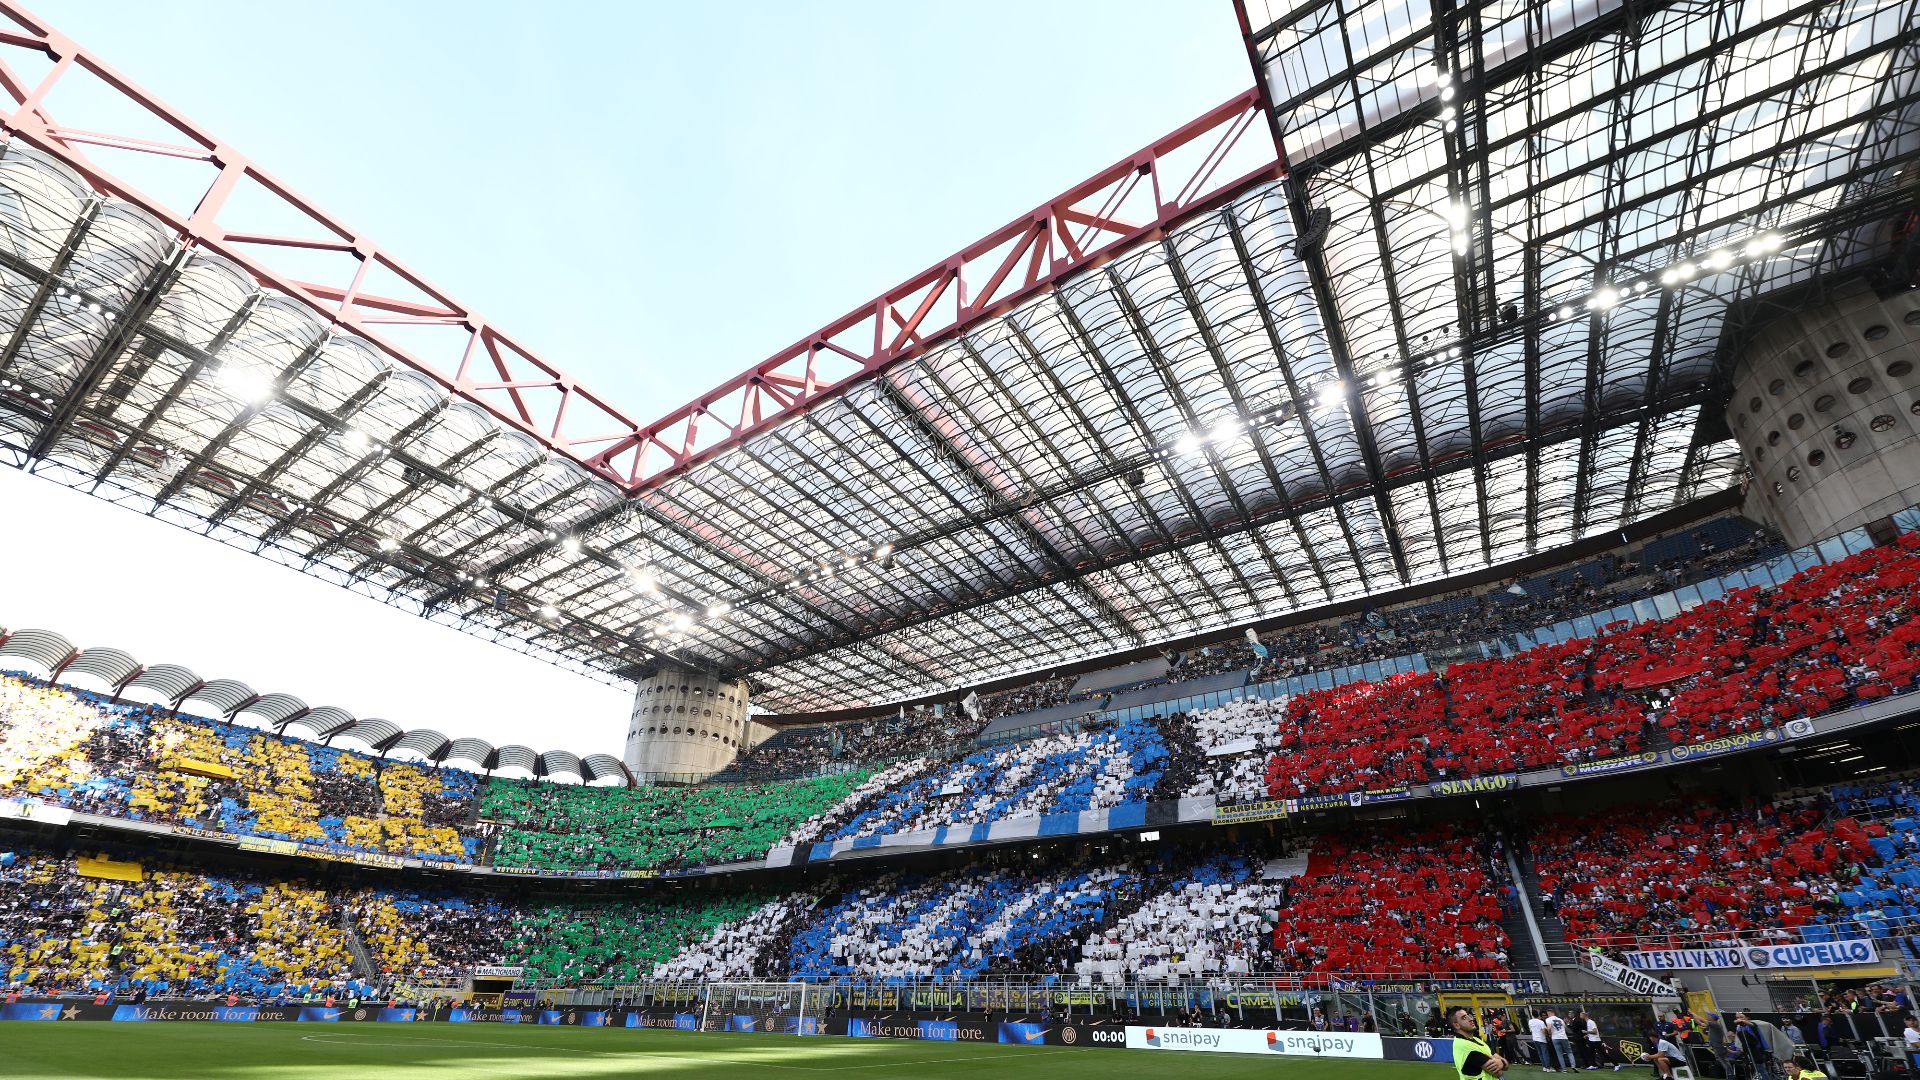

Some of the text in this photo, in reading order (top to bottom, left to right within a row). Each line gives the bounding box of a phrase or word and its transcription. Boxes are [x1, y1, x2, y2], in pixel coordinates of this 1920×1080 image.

[1689, 732, 1762, 754] FROSINONE
[911, 751, 929, 759] LAZIO
[1580, 760, 1644, 773] MOZZATE
[1441, 775, 1507, 795] SENAGO
[1304, 795, 1344, 803] PAULLO
[1223, 801, 1273, 813] GARDEN'S
[1301, 801, 1348, 811] NERAZZURRA
[364, 853, 396, 864] MOLE
[620, 869, 653, 878] CIVIDALE
[1774, 942, 1870, 965] CUPELLO
[910, 992, 963, 1006] ALTAVILLA
[132, 1007, 286, 1021] Make room for more.
[462, 1010, 487, 1021] Make
[635, 1015, 657, 1027] Make
[658, 1017, 677, 1028] room
[679, 1015, 692, 1029] for
[859, 1021, 985, 1039] Make room for more.
[1092, 1030, 1125, 1043] 00:00
[1163, 1031, 1221, 1047] snaipay
[1287, 1035, 1354, 1052] snaipay
